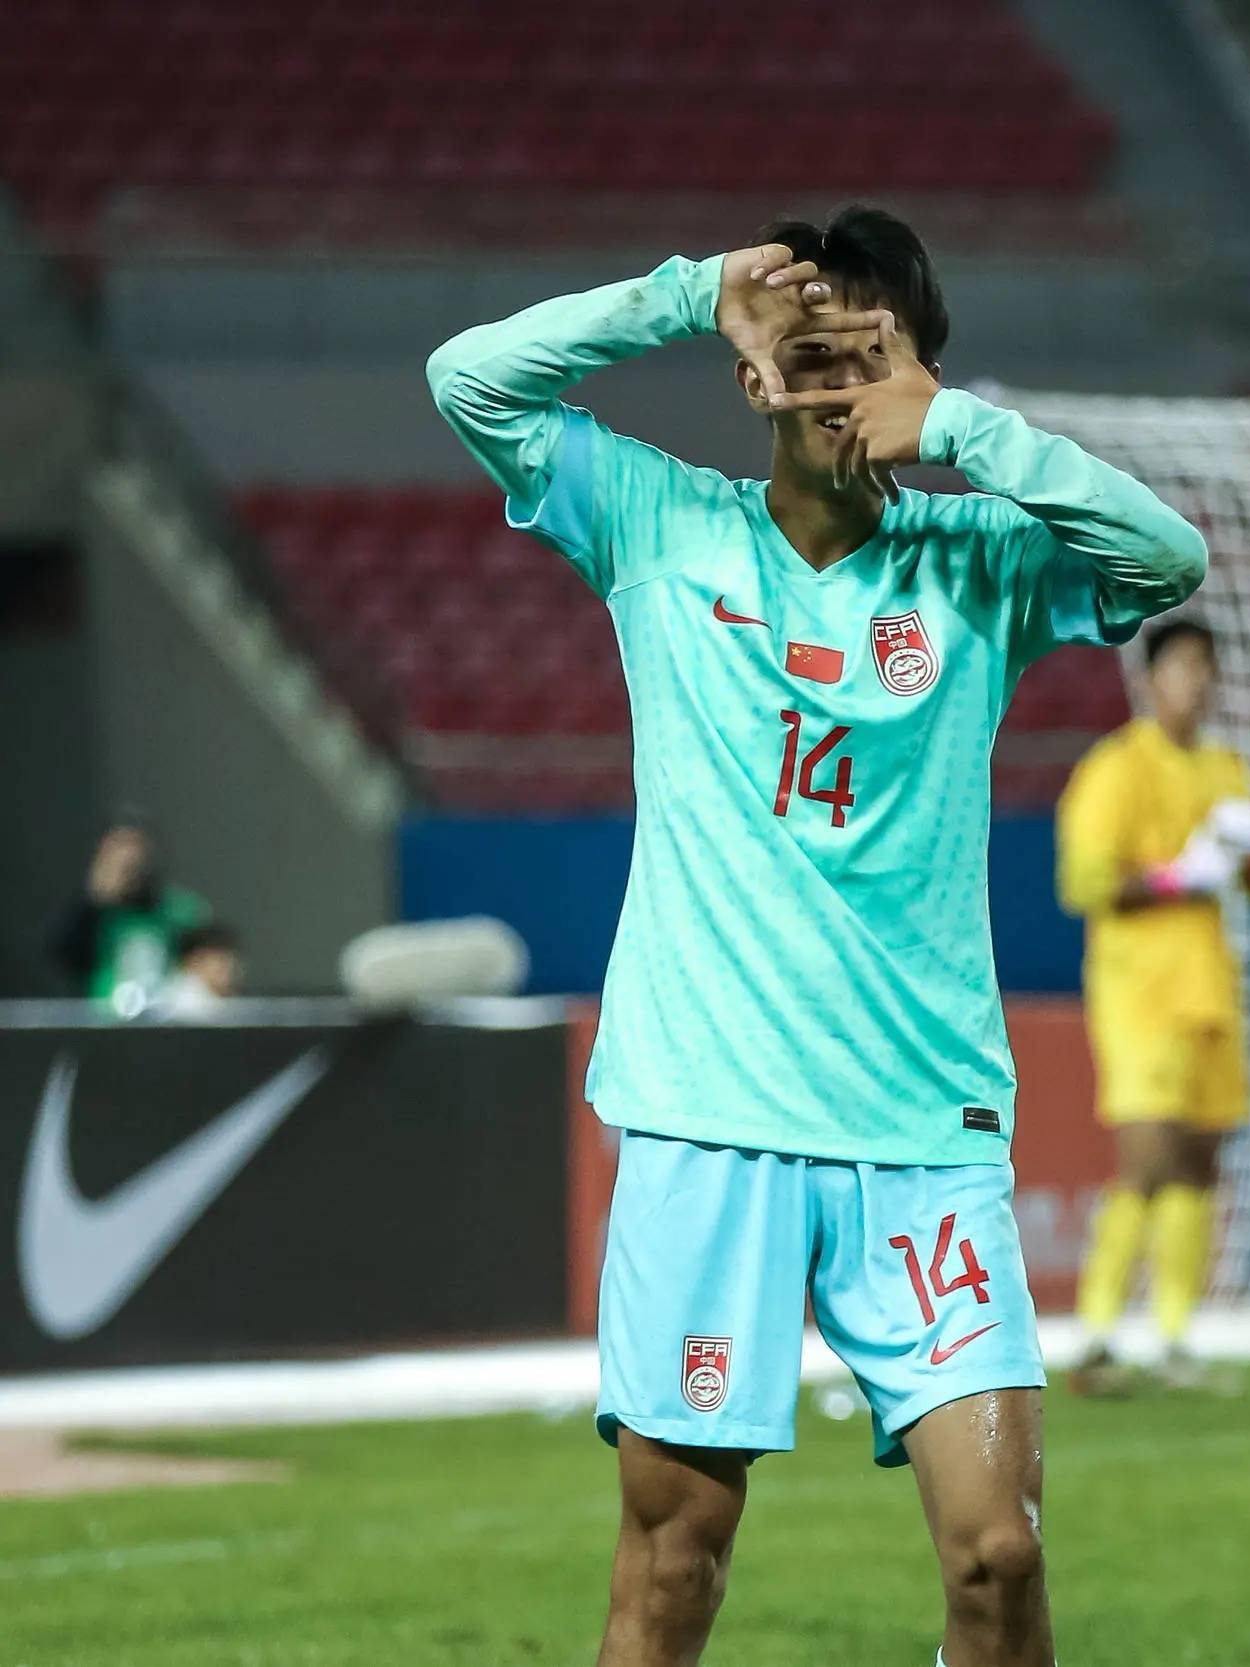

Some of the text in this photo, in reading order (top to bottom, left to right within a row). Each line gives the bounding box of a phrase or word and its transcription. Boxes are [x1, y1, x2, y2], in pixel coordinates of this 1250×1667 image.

[874, 619, 918, 641] CFA
[773, 708, 855, 828] 14
[888, 1213, 990, 1326] 14
[688, 1343, 728, 1357] CFA
